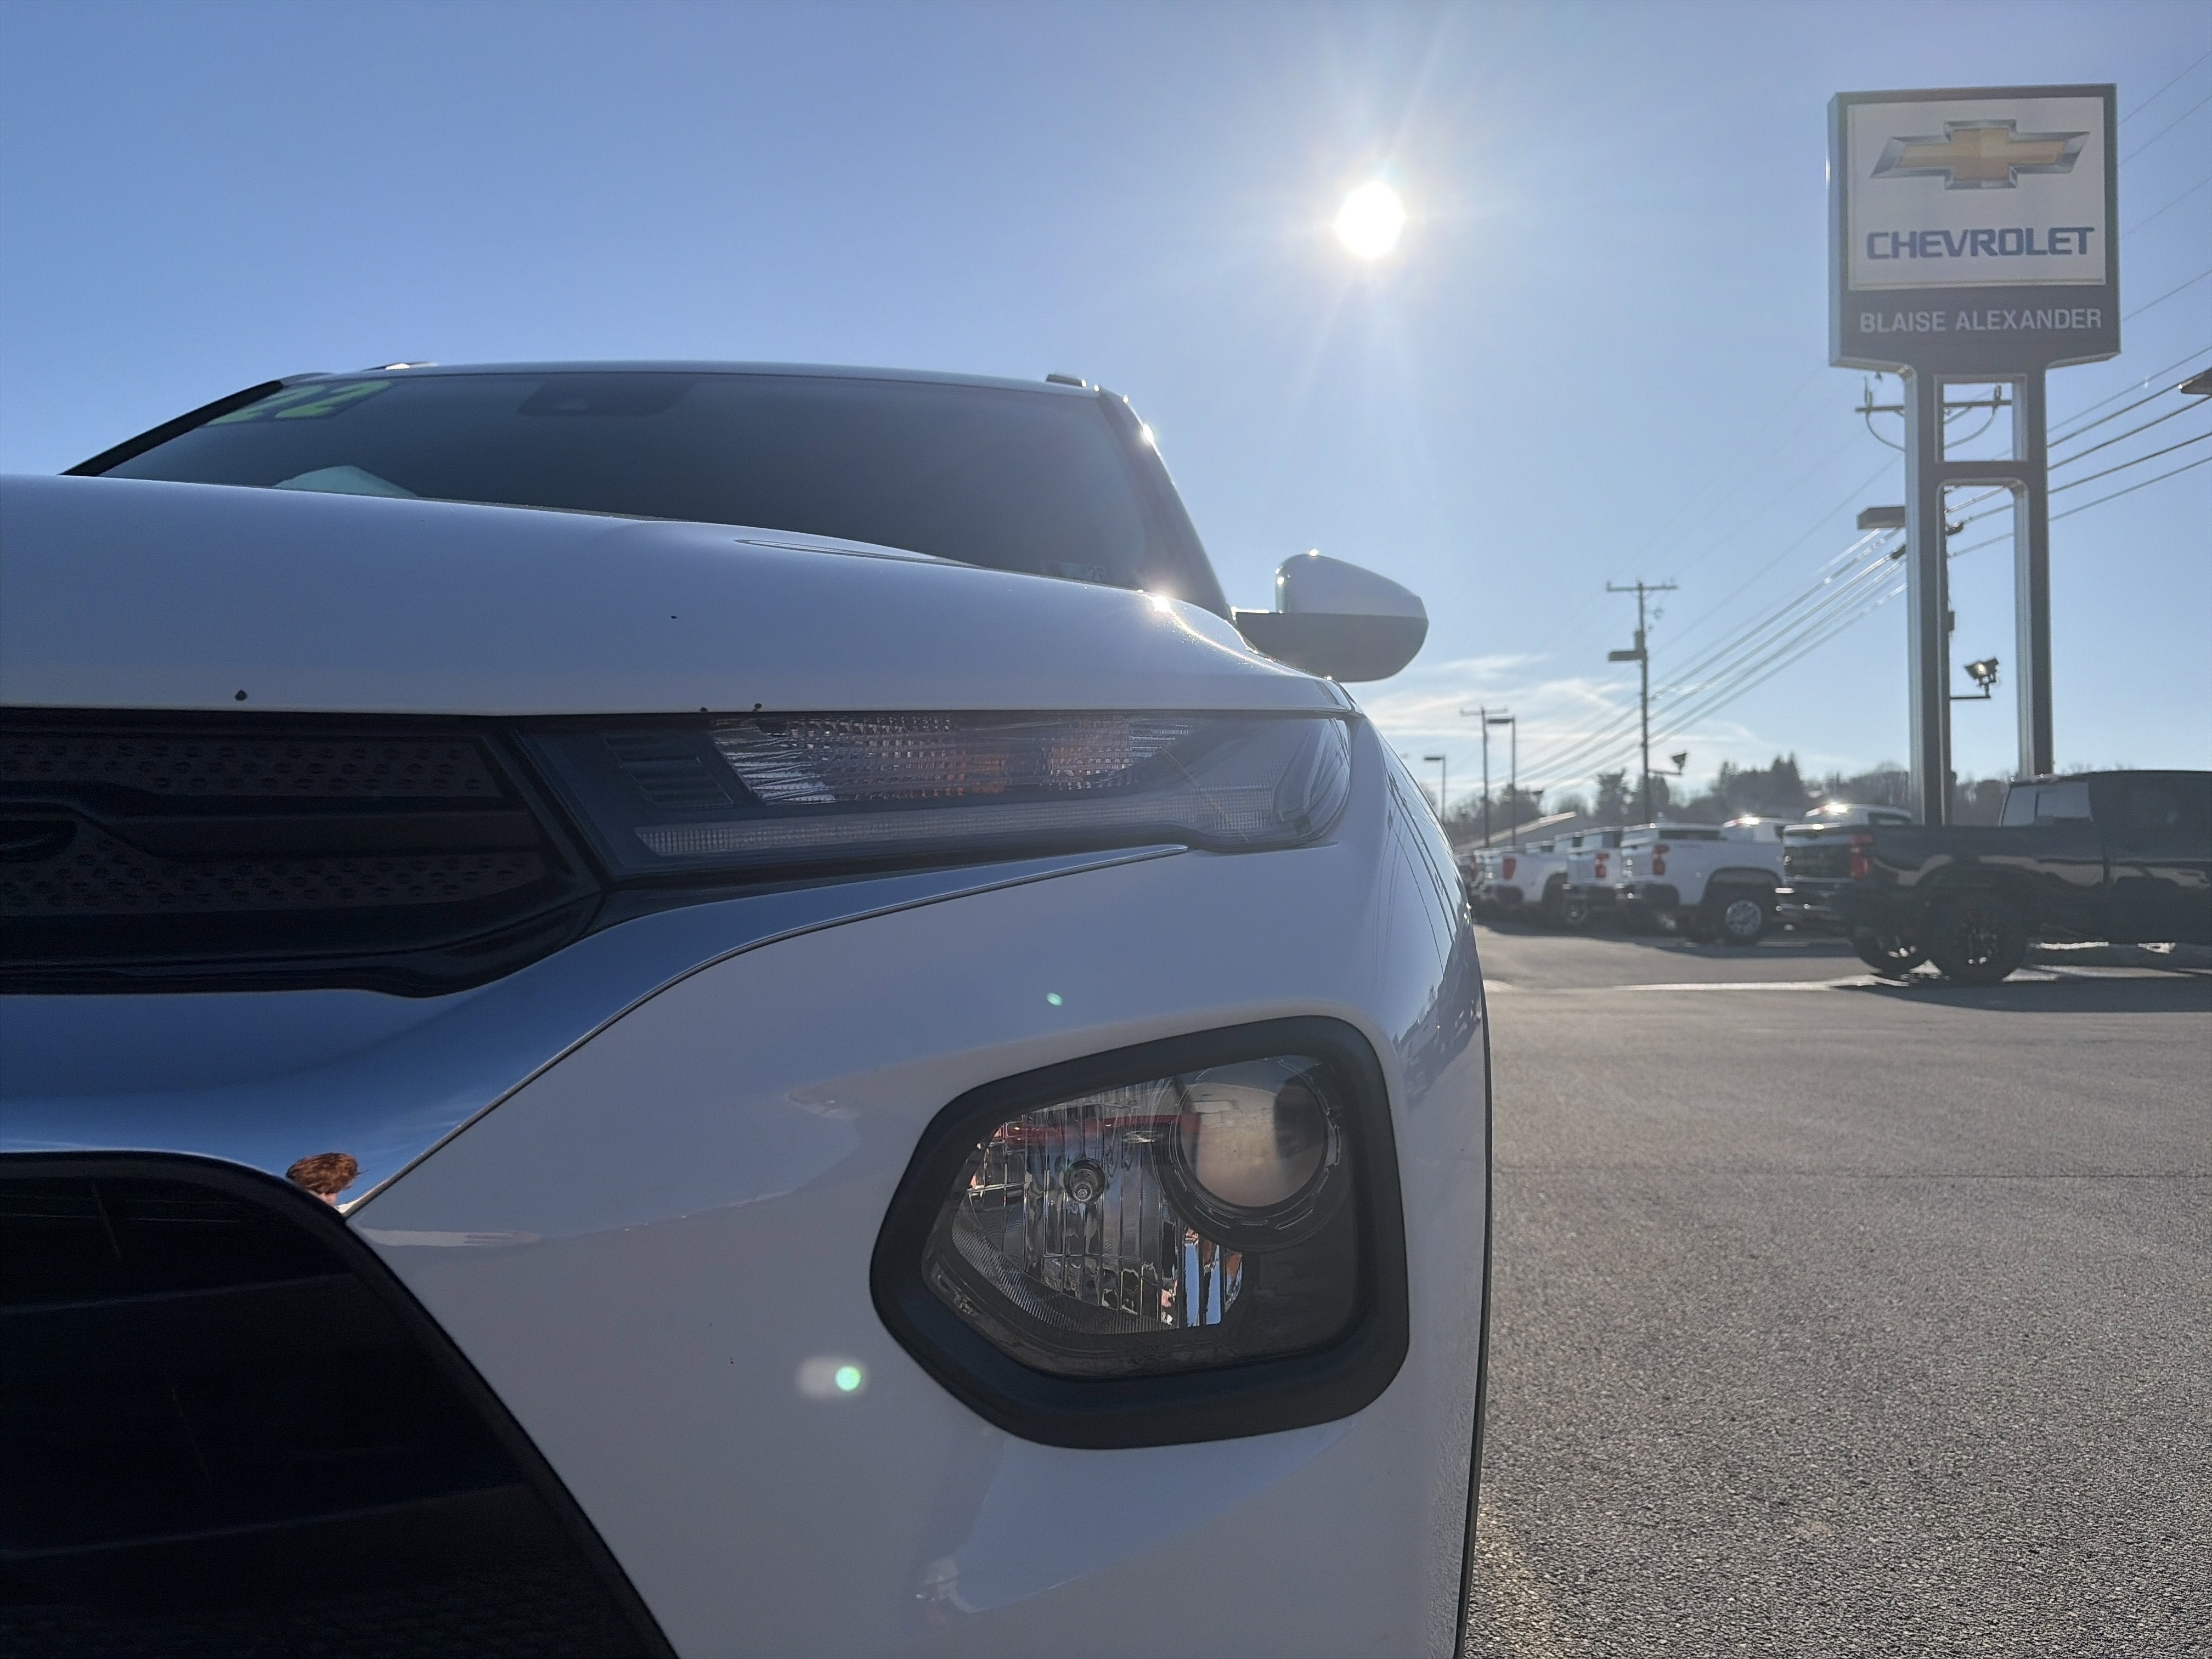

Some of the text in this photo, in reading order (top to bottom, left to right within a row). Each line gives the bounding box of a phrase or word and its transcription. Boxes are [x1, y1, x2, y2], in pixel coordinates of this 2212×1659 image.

[1867, 227, 2095, 260] CHEVROLET
[1859, 308, 2102, 334] BLAISE ALEXANDER
